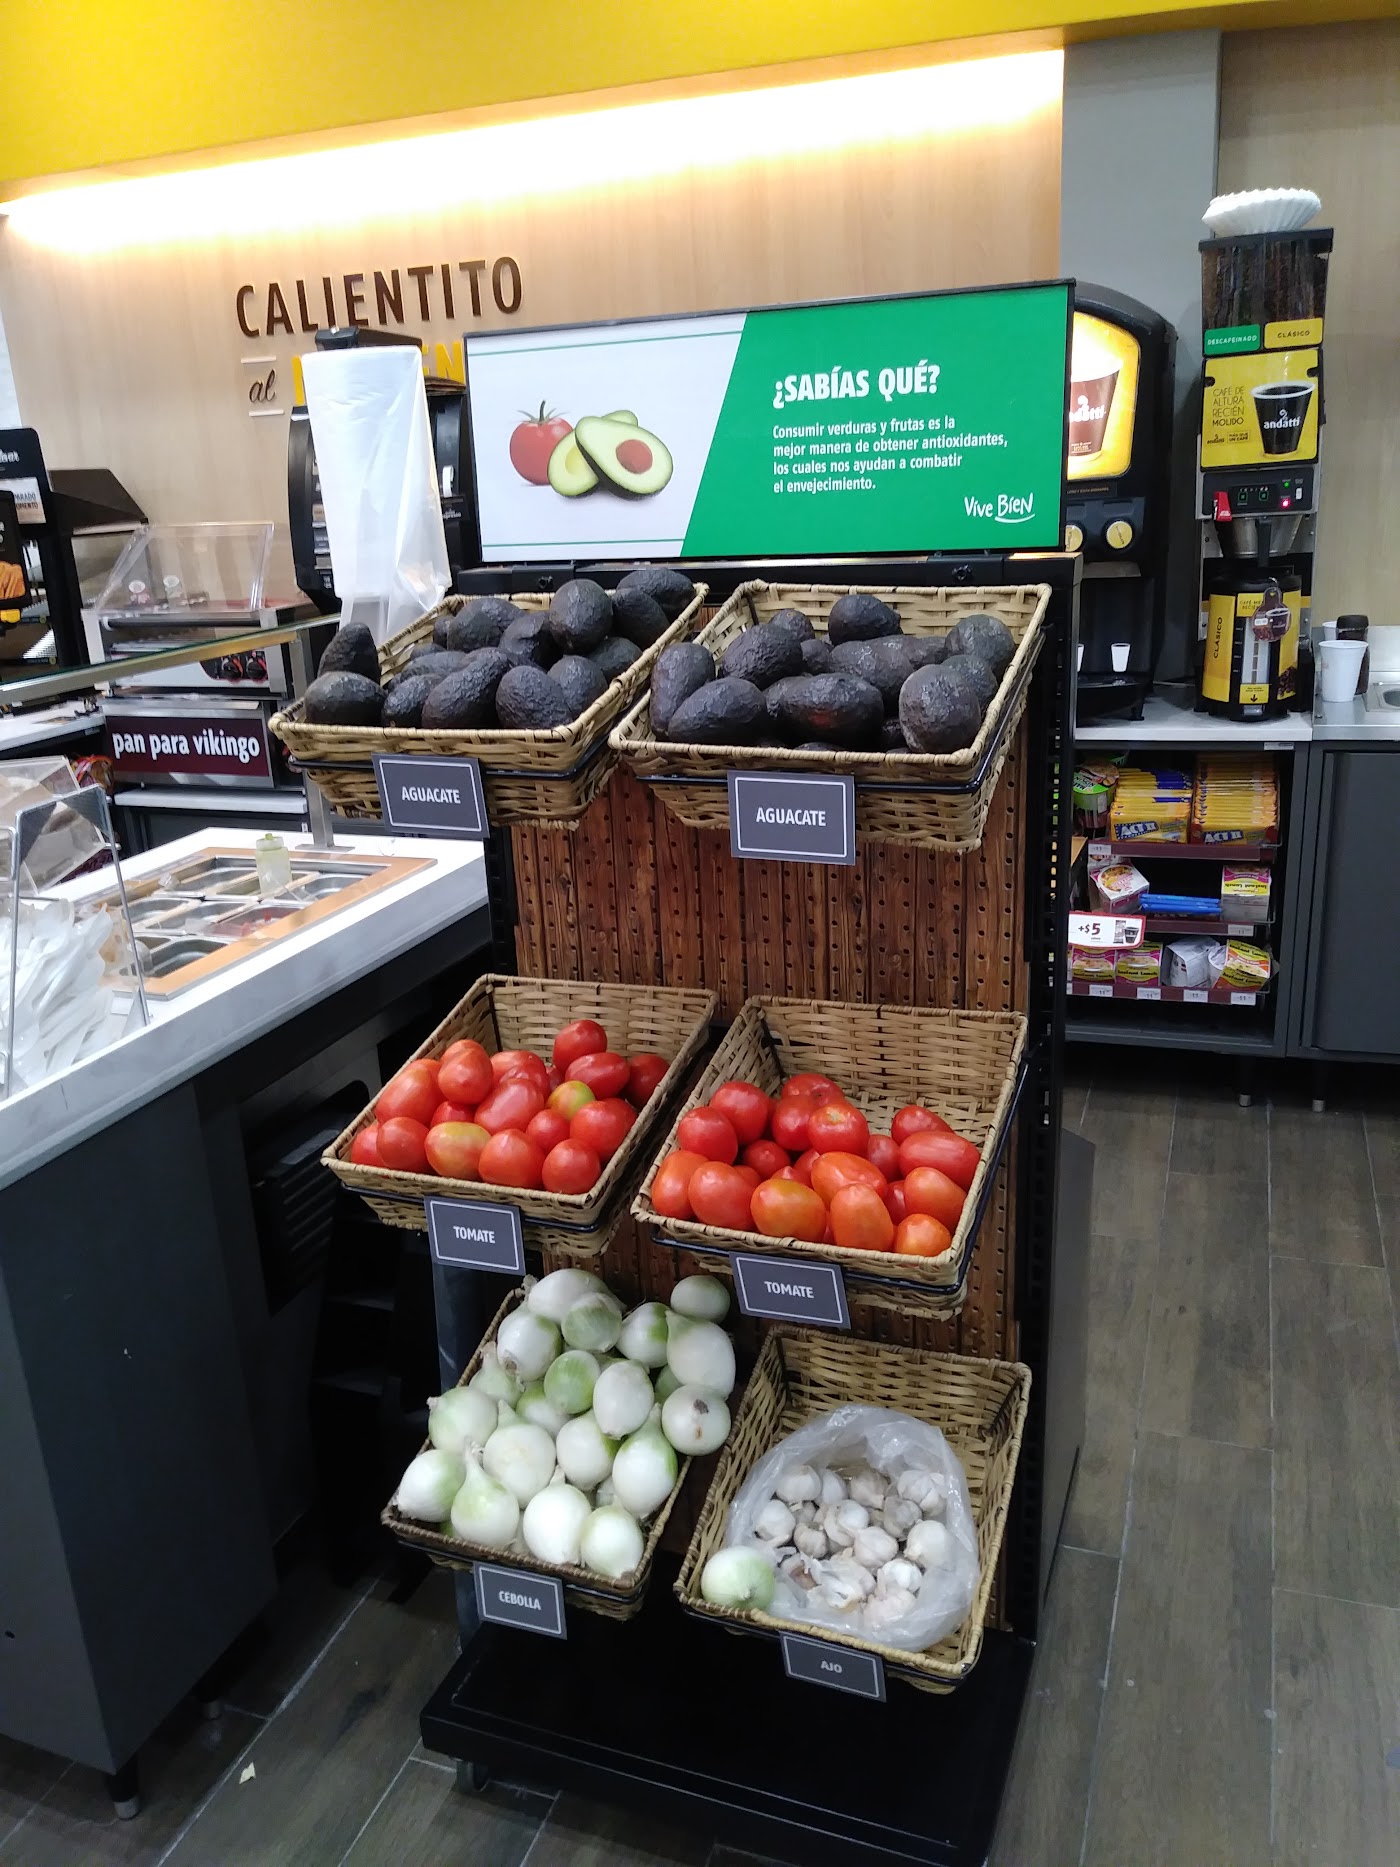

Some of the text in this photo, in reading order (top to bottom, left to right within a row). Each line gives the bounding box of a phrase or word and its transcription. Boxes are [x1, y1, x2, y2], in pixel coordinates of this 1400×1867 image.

[236, 257, 522, 337] CALIENTITO
[1207, 335, 1258, 346] DESCAFEINADO
[1277, 330, 1311, 339] CLÁSICO
[249, 370, 276, 402] al
[772, 359, 940, 409] ¿SABÍAS QUÉ?
[1212, 385, 1245, 396] CAFÉ DE
[1213, 396, 1245, 406] ALTURA
[1212, 406, 1245, 417] RECIÉN
[773, 415, 955, 438] Consumir verduras y frutas es la
[1212, 417, 1245, 427] MOLIDO
[773, 432, 1008, 459] mejor manera de obtener antioxidantes,
[773, 453, 963, 475] los cuales nos ayudan a combatir
[773, 475, 876, 494] el envejecimiento.
[964, 496, 994, 517] Vive
[112, 728, 260, 764] pan para vikingo
[401, 786, 460, 804] AGUACATE
[755, 806, 826, 827] AGUACATE
[453, 1225, 495, 1244] TOMATE
[764, 1280, 813, 1299] TOMATE
[499, 1590, 541, 1611] CEBOLLA
[821, 1659, 842, 1674] AJO
